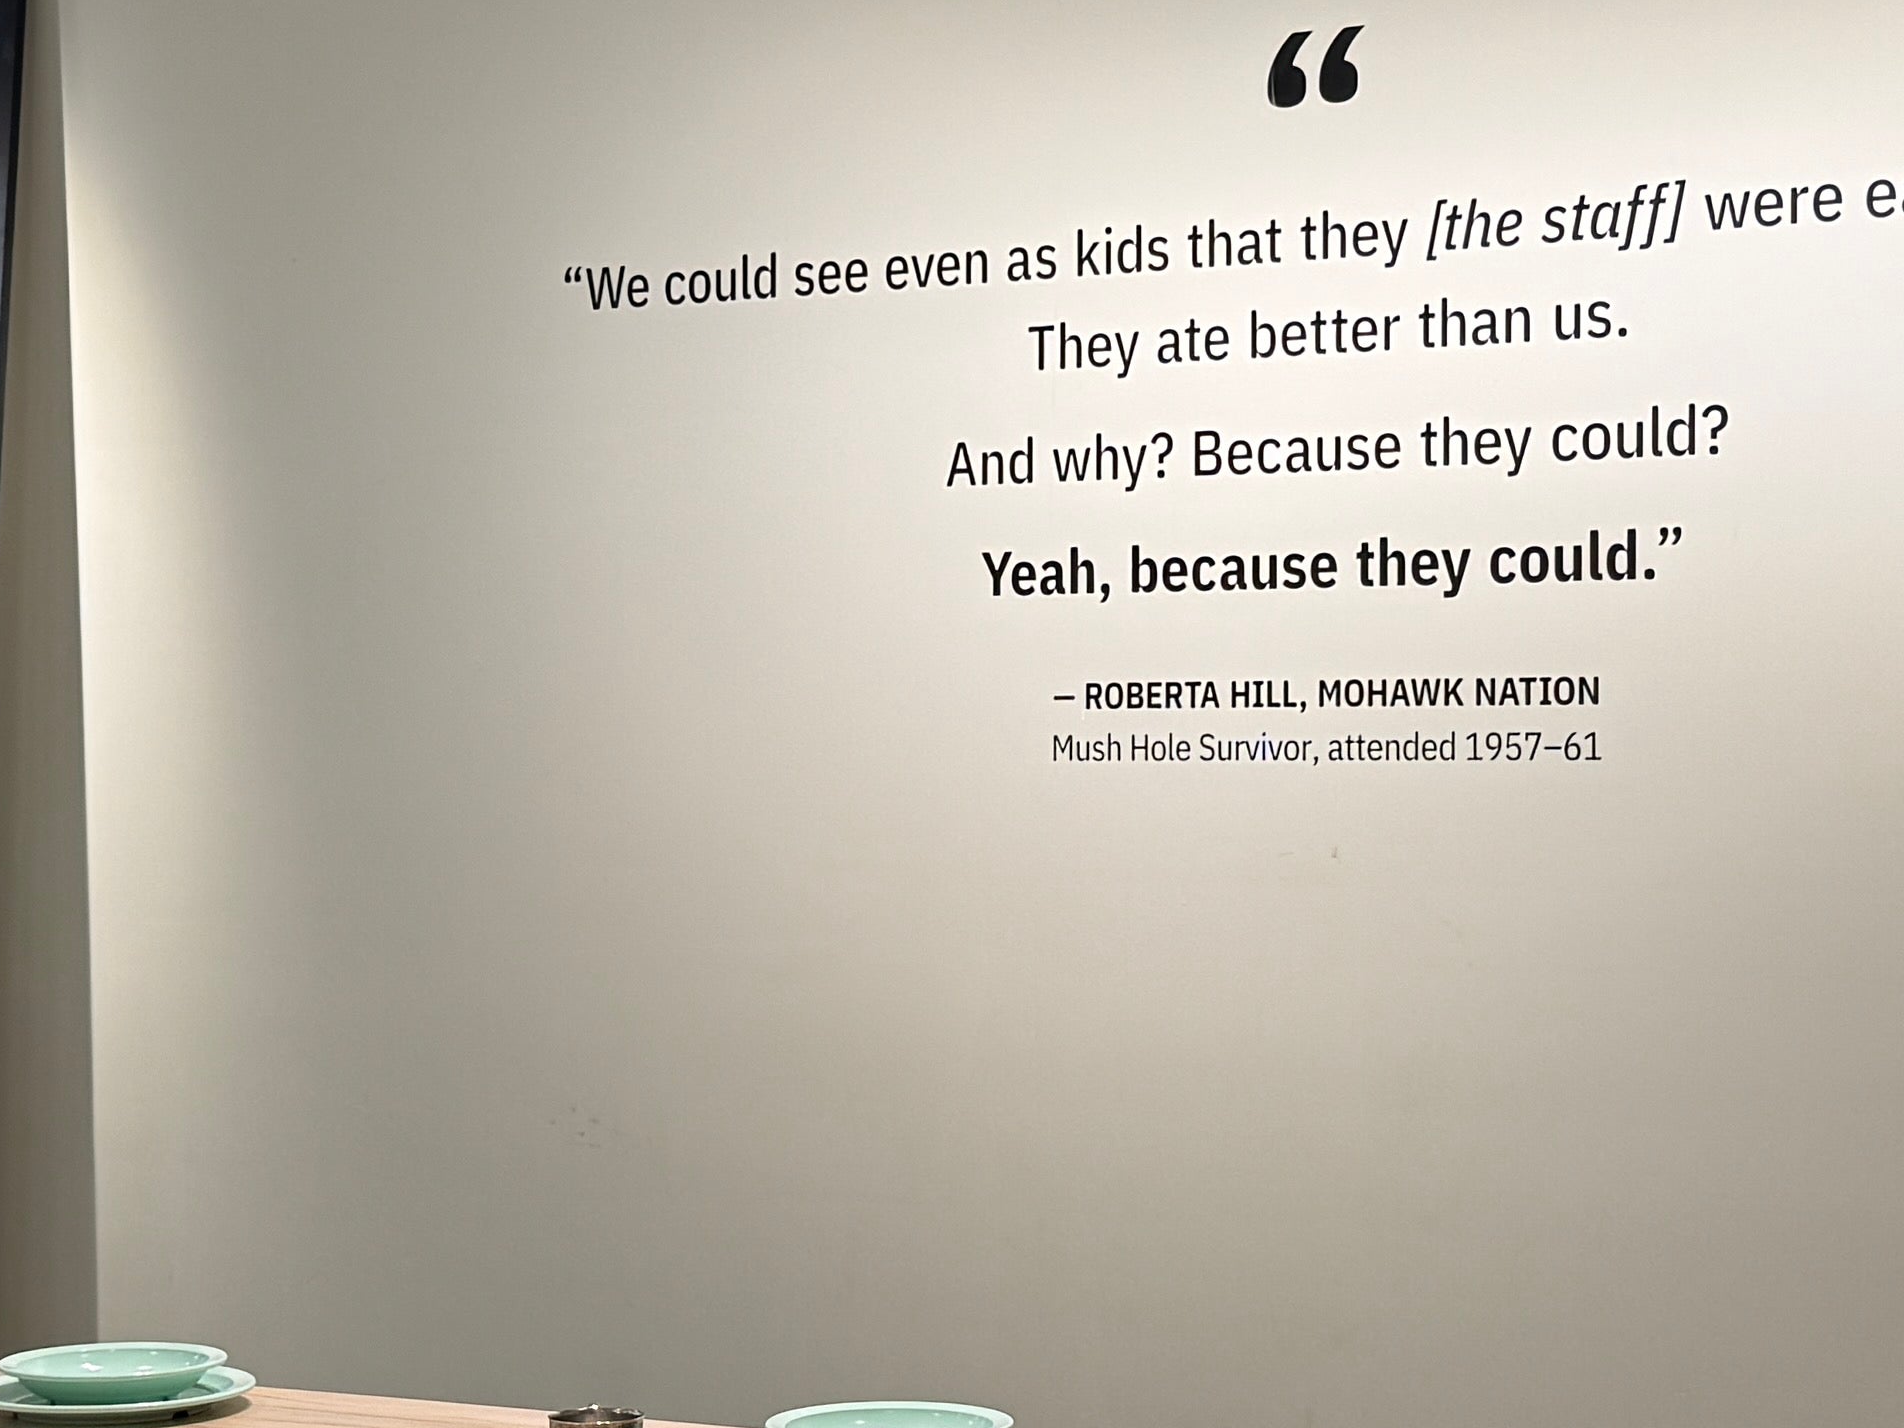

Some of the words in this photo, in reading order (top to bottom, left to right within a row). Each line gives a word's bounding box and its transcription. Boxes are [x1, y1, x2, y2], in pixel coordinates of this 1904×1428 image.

[565, 266, 649, 310] “We
[665, 252, 776, 305] could
[795, 259, 868, 296] see
[886, 250, 987, 290] even
[1008, 245, 1056, 281] as
[1078, 225, 1168, 276] kids
[1188, 219, 1281, 267] that
[1301, 210, 1408, 268] they
[1427, 199, 1522, 261] [the
[1542, 180, 1686, 251] staff]
[1705, 184, 1842, 230] were
[1029, 322, 1139, 378] They
[1158, 319, 1229, 363] ate
[1251, 310, 1400, 358] better
[1419, 298, 1530, 347] than
[1556, 301, 1627, 340] us.
[947, 436, 1033, 486] And
[1053, 432, 1173, 492] why?
[1195, 431, 1400, 476] Because
[1421, 416, 1531, 477] they
[1553, 404, 1728, 461] could?
[982, 547, 1110, 603] Yeah,
[1132, 545, 1337, 592] because
[1357, 537, 1470, 598] they
[1490, 527, 1681, 583] could.”
[1086, 681, 1219, 709] ROBERTA
[1232, 680, 1306, 713] HILL,
[1319, 678, 1463, 707] MOHAWK
[1476, 677, 1599, 706] NATION
[1054, 733, 1121, 761] Mush
[1132, 733, 1190, 761] Hole
[1200, 732, 1318, 765] Survivor,
[1329, 731, 1455, 761] attended
[1467, 732, 1601, 760] 1957–61
